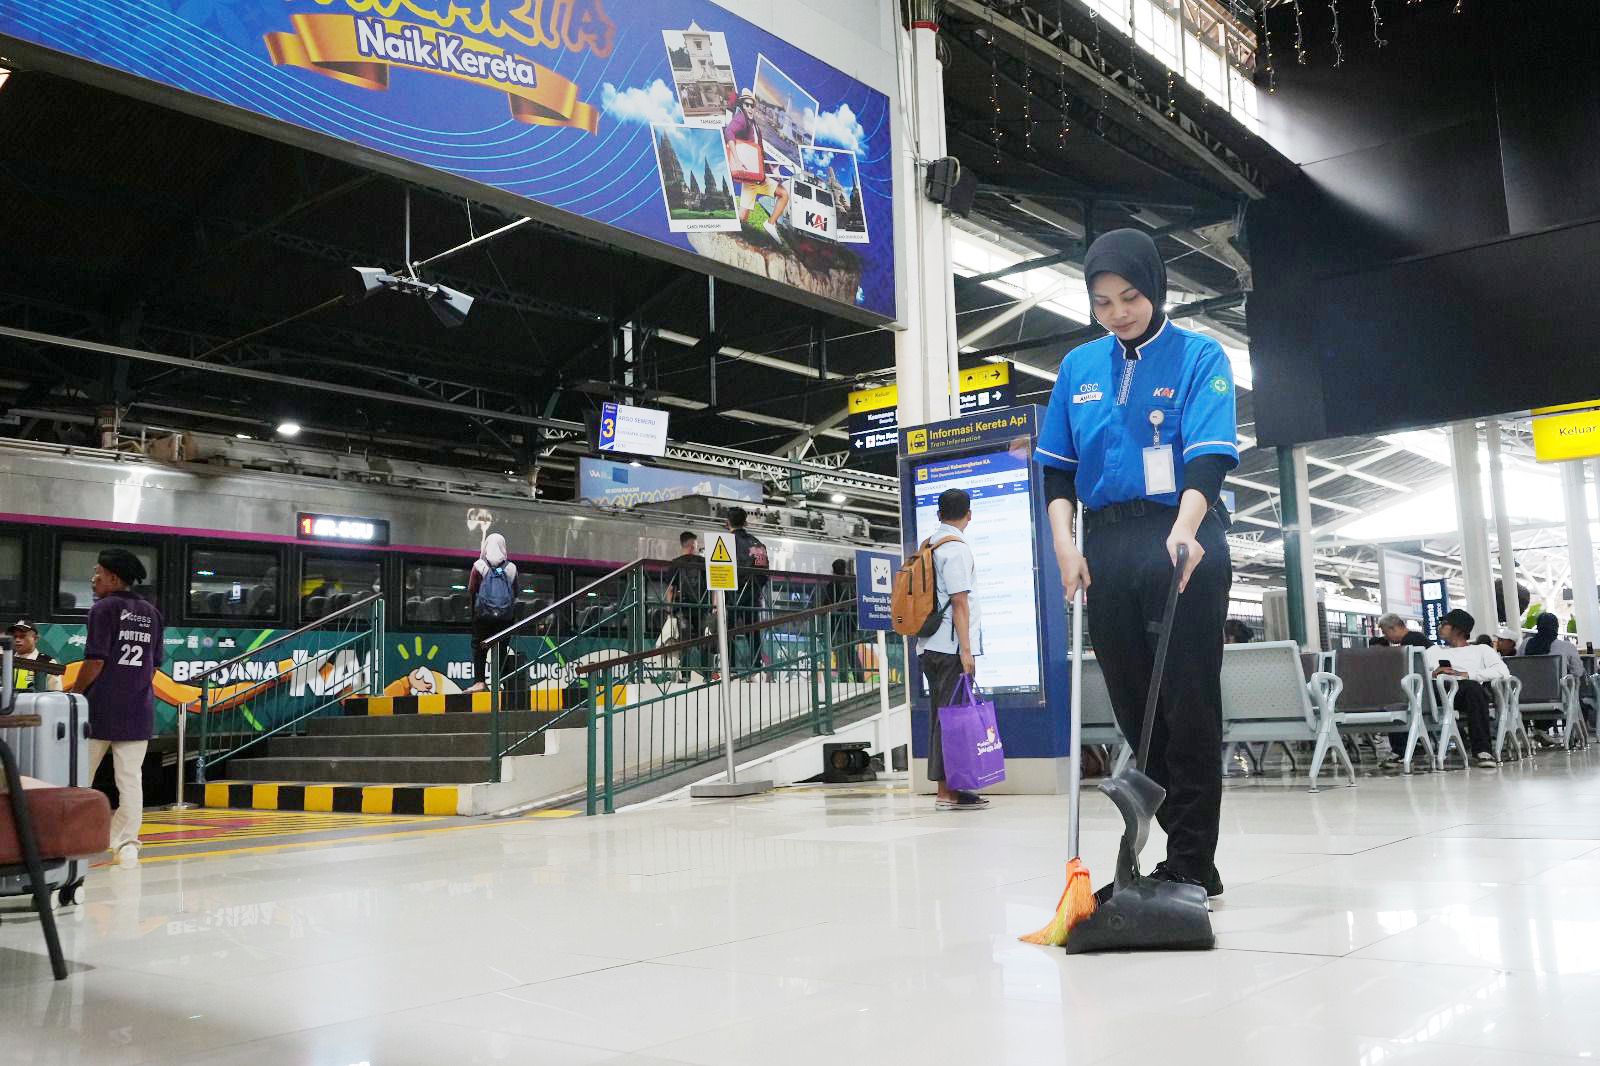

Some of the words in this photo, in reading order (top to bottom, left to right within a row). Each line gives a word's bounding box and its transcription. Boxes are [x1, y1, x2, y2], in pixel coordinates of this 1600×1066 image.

[357, 18, 436, 66] Naik
[438, 32, 536, 86] Kereta
[805, 210, 828, 232] KAI
[1080, 383, 1098, 392] OSC
[1153, 387, 1175, 399] KAI
[602, 418, 615, 438] 3
[929, 423, 974, 440] Informasi
[975, 418, 1007, 432] Kereta
[1009, 413, 1028, 426] Api
[1559, 425, 1597, 437] Keluar
[930, 440, 946, 448] Train
[946, 436, 981, 447] Information
[301, 518, 312, 534] 1
[119, 630, 151, 643] PORTER
[117, 643, 143, 667] 22
